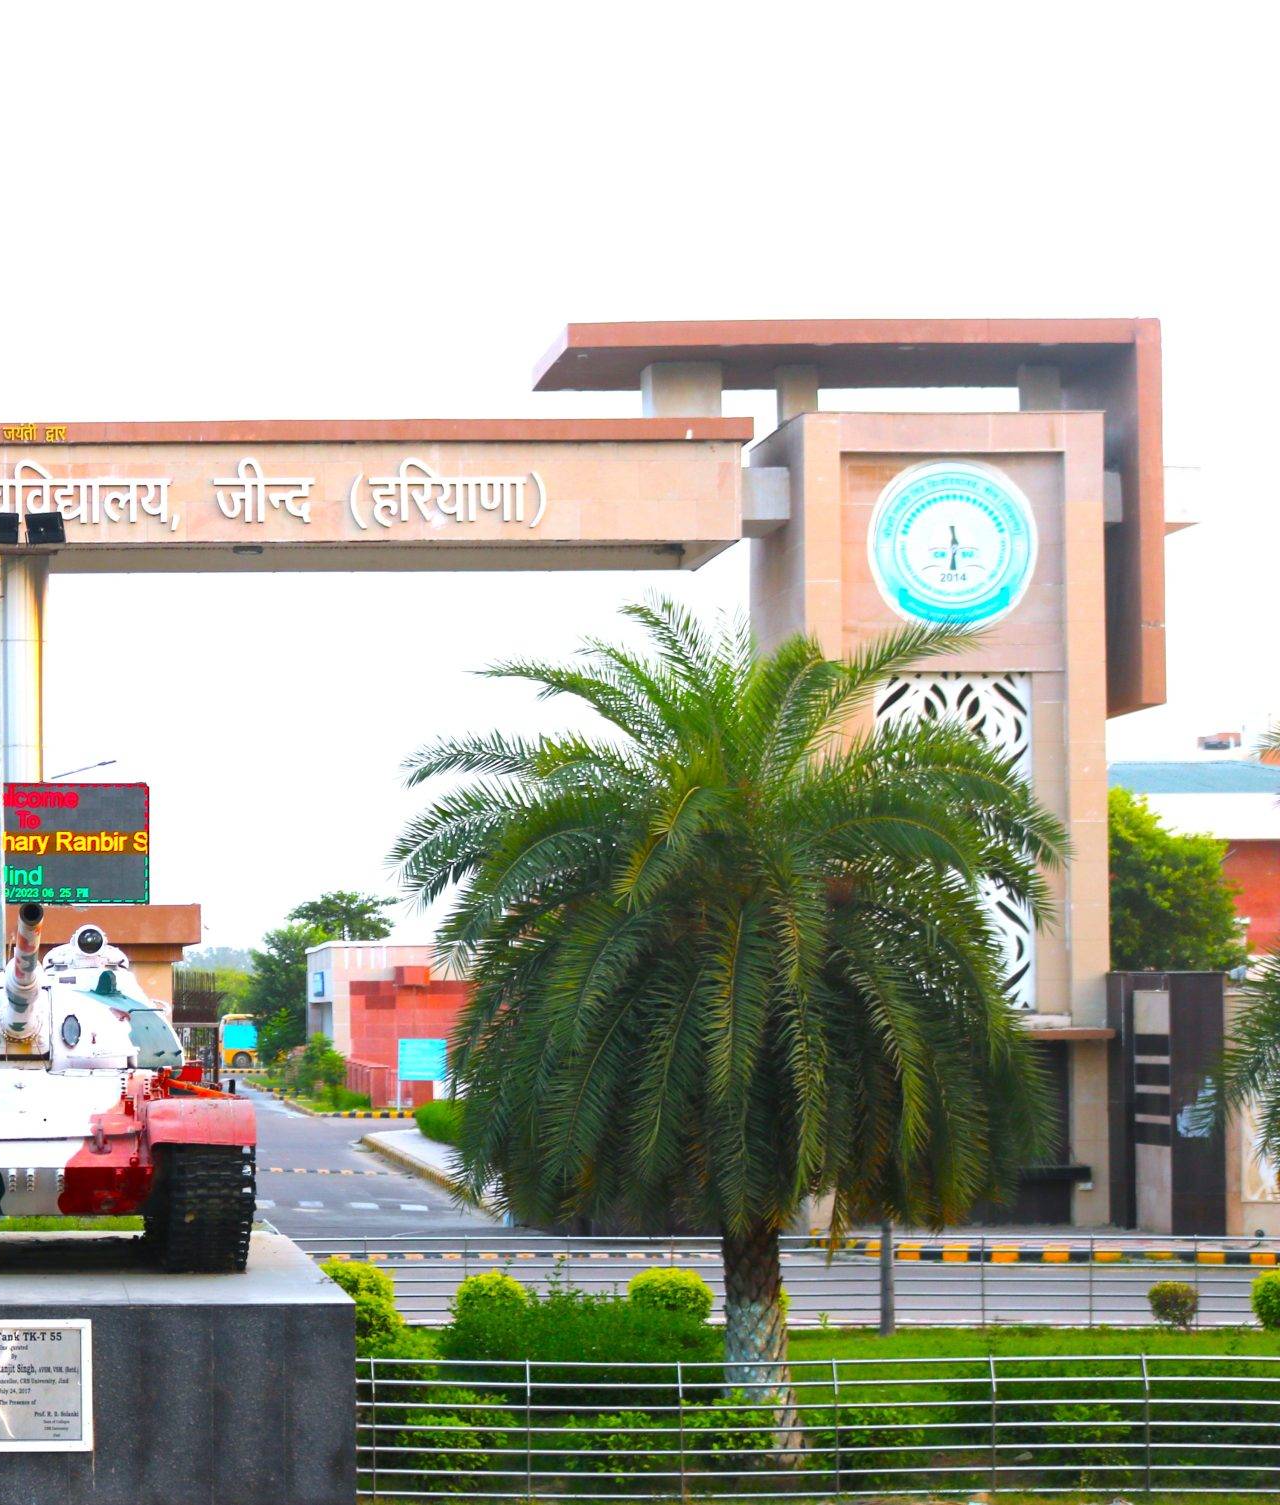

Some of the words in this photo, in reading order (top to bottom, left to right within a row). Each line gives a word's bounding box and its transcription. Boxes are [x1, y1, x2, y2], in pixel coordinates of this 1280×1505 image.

[214, 457, 316, 524] जीन्द
[350, 456, 546, 530] (हरियाणा)
[940, 572, 967, 583] 2014
[15, 810, 41, 830] To
[56, 831, 128, 852] Ranbir
[76, 887, 90, 898] PM
[23, 1332, 46, 1341] TK-T
[50, 1332, 62, 1341] 55
[17, 1364, 36, 1375] Singh,
